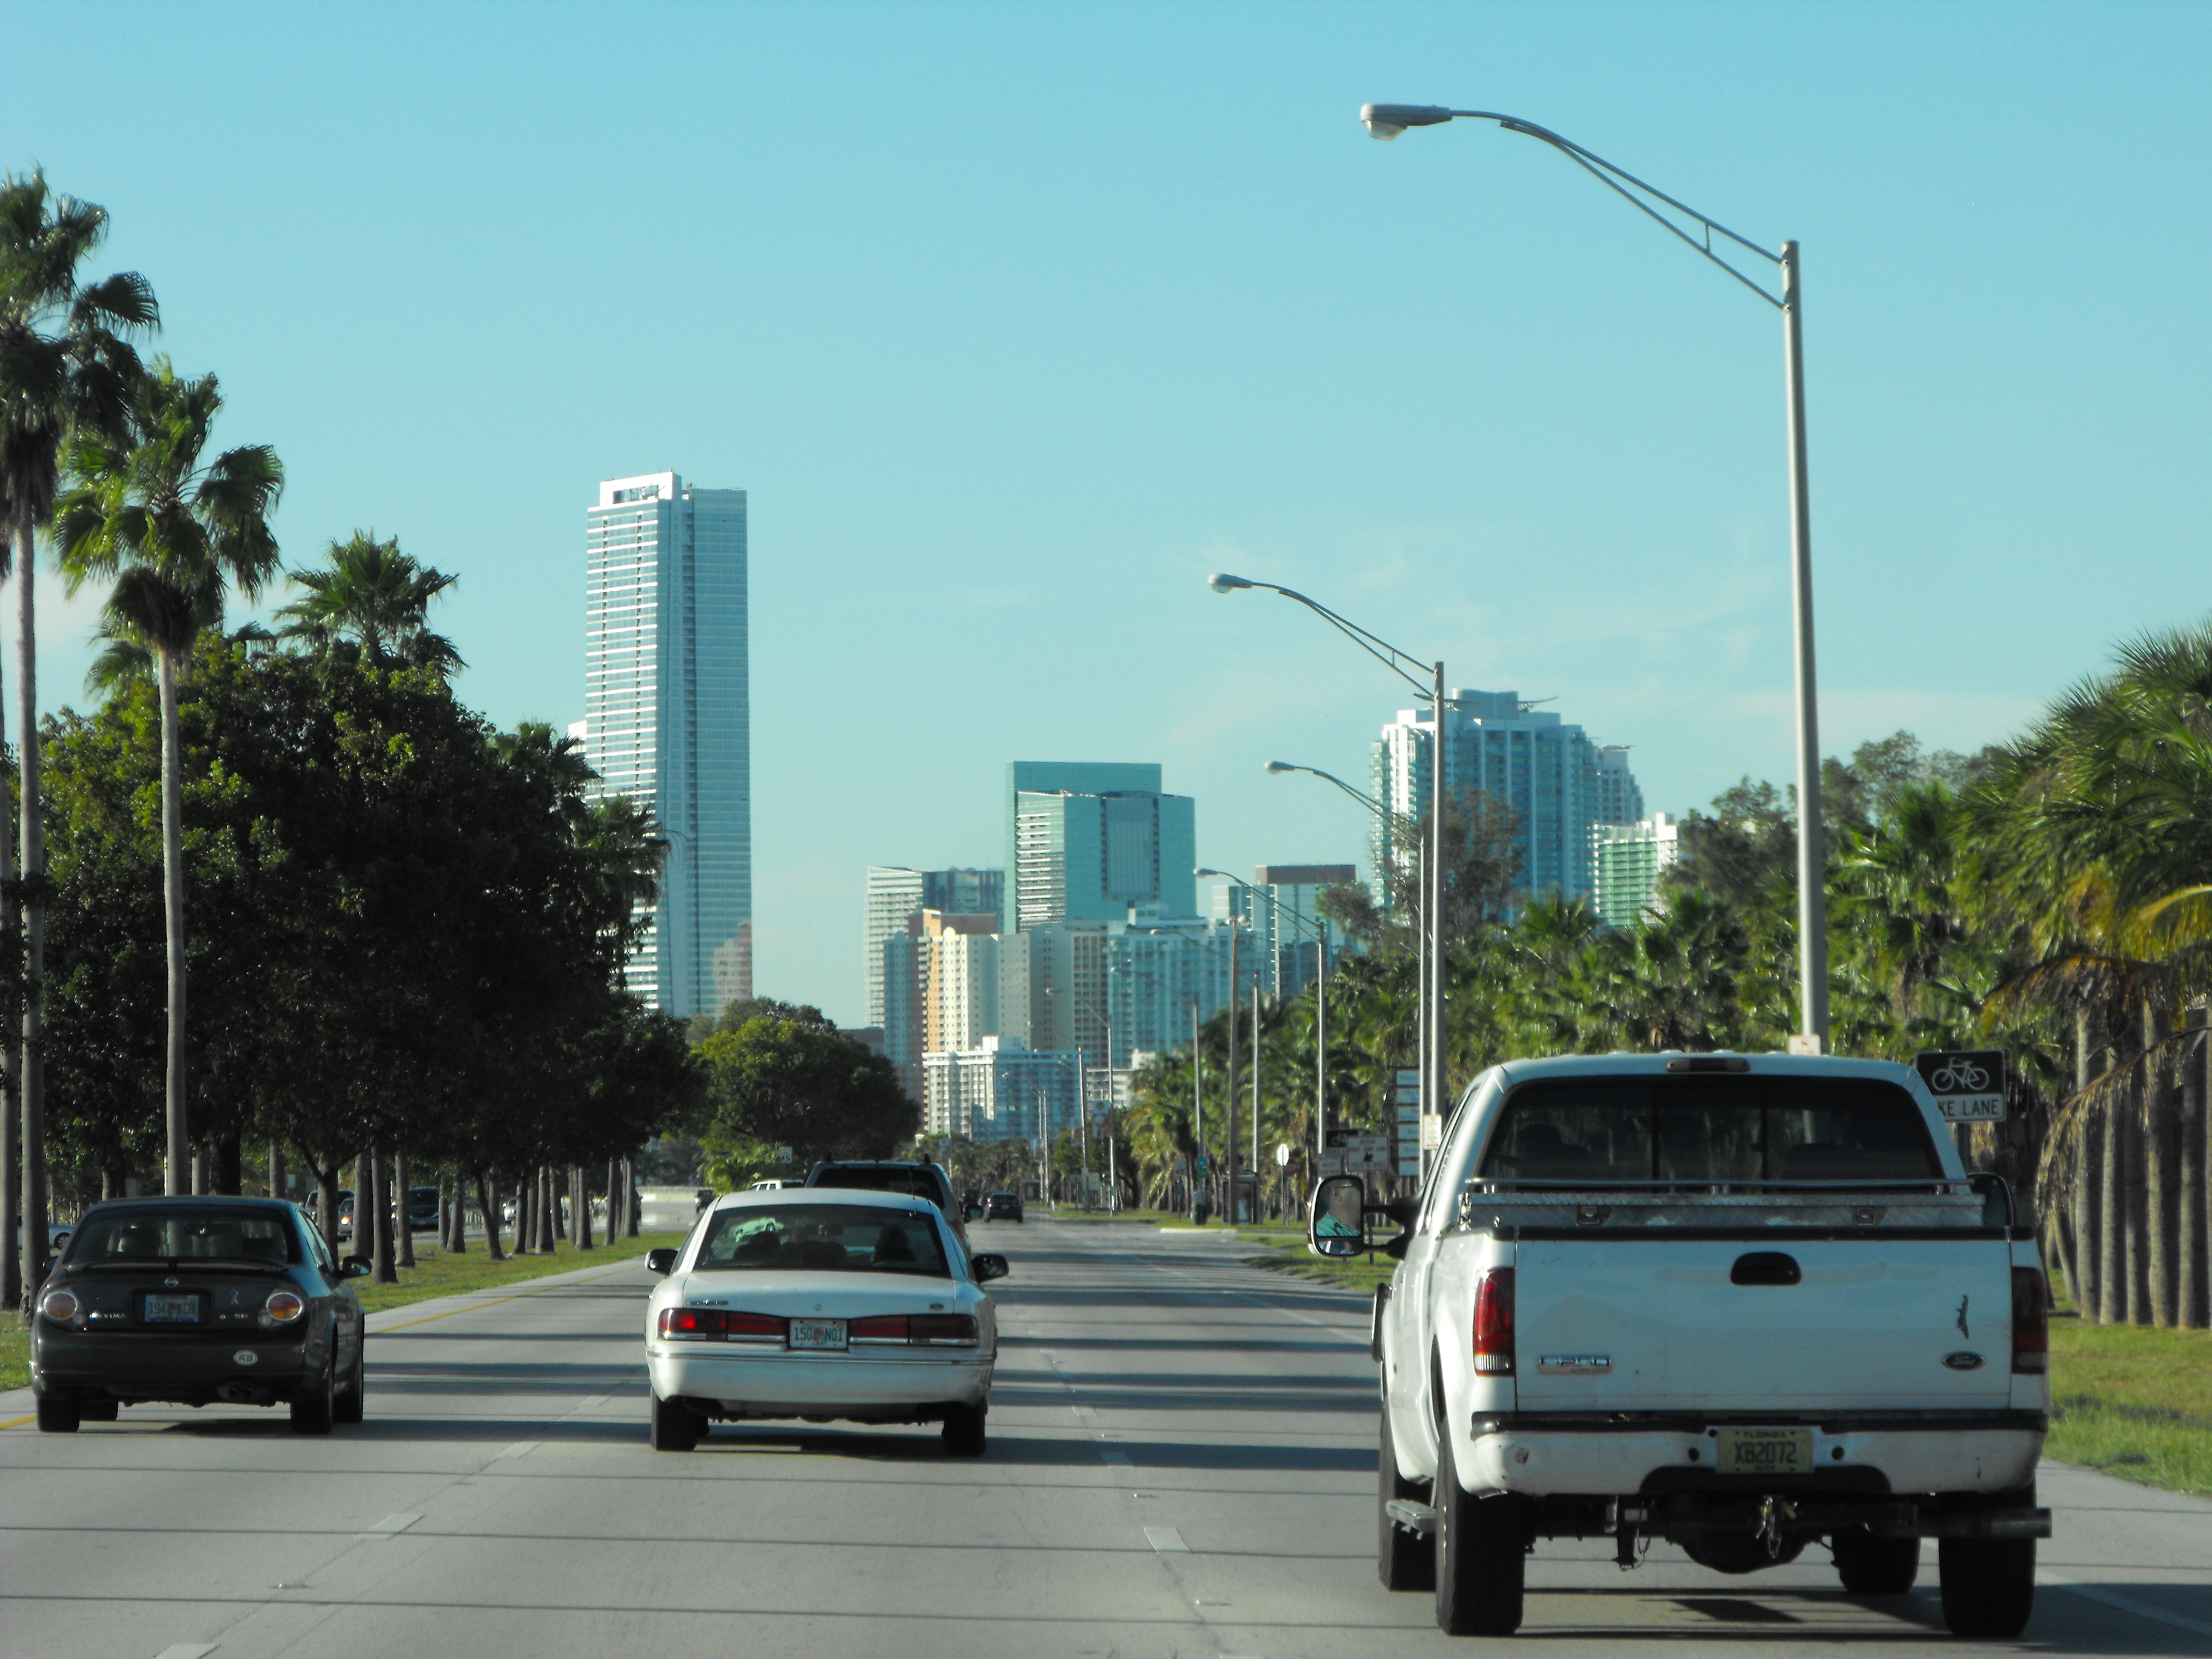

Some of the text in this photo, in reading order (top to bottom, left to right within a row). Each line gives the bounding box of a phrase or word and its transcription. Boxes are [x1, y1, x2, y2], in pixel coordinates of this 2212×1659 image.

[1938, 1099, 1999, 1117] KE LANE
[149, 1302, 166, 1315] 194
[794, 1327, 812, 1341] 150
[1953, 1355, 1976, 1366] Ford
[1734, 1441, 1797, 1463] XB2072
